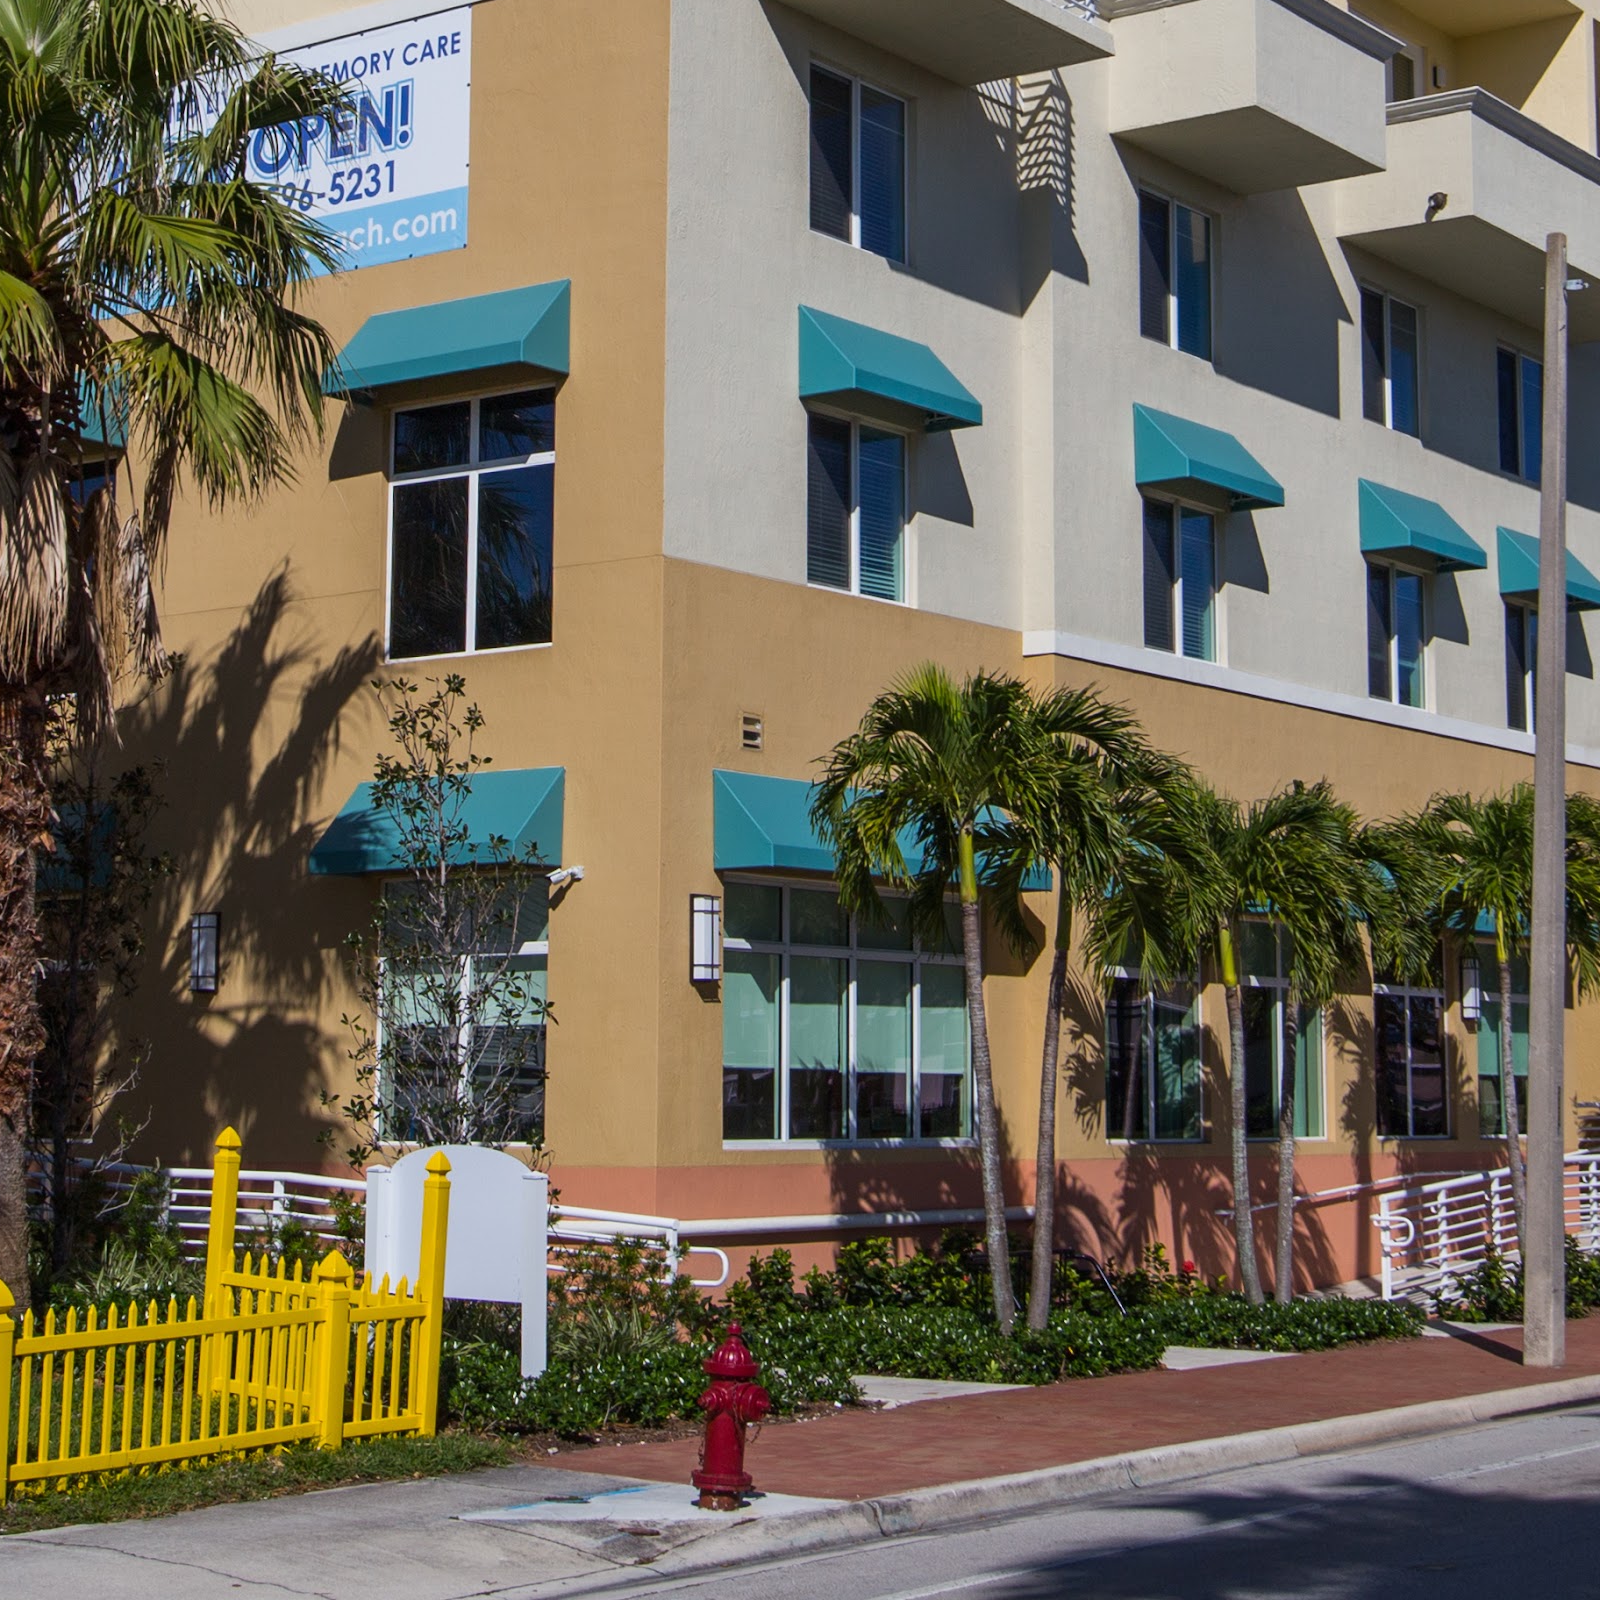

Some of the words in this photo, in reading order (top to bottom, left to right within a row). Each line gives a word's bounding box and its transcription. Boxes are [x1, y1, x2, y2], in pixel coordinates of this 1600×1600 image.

[303, 48, 396, 88] EMORY
[402, 31, 461, 66] CARE
[250, 81, 413, 177] OPEN!
[268, 160, 395, 212] 96-5231
